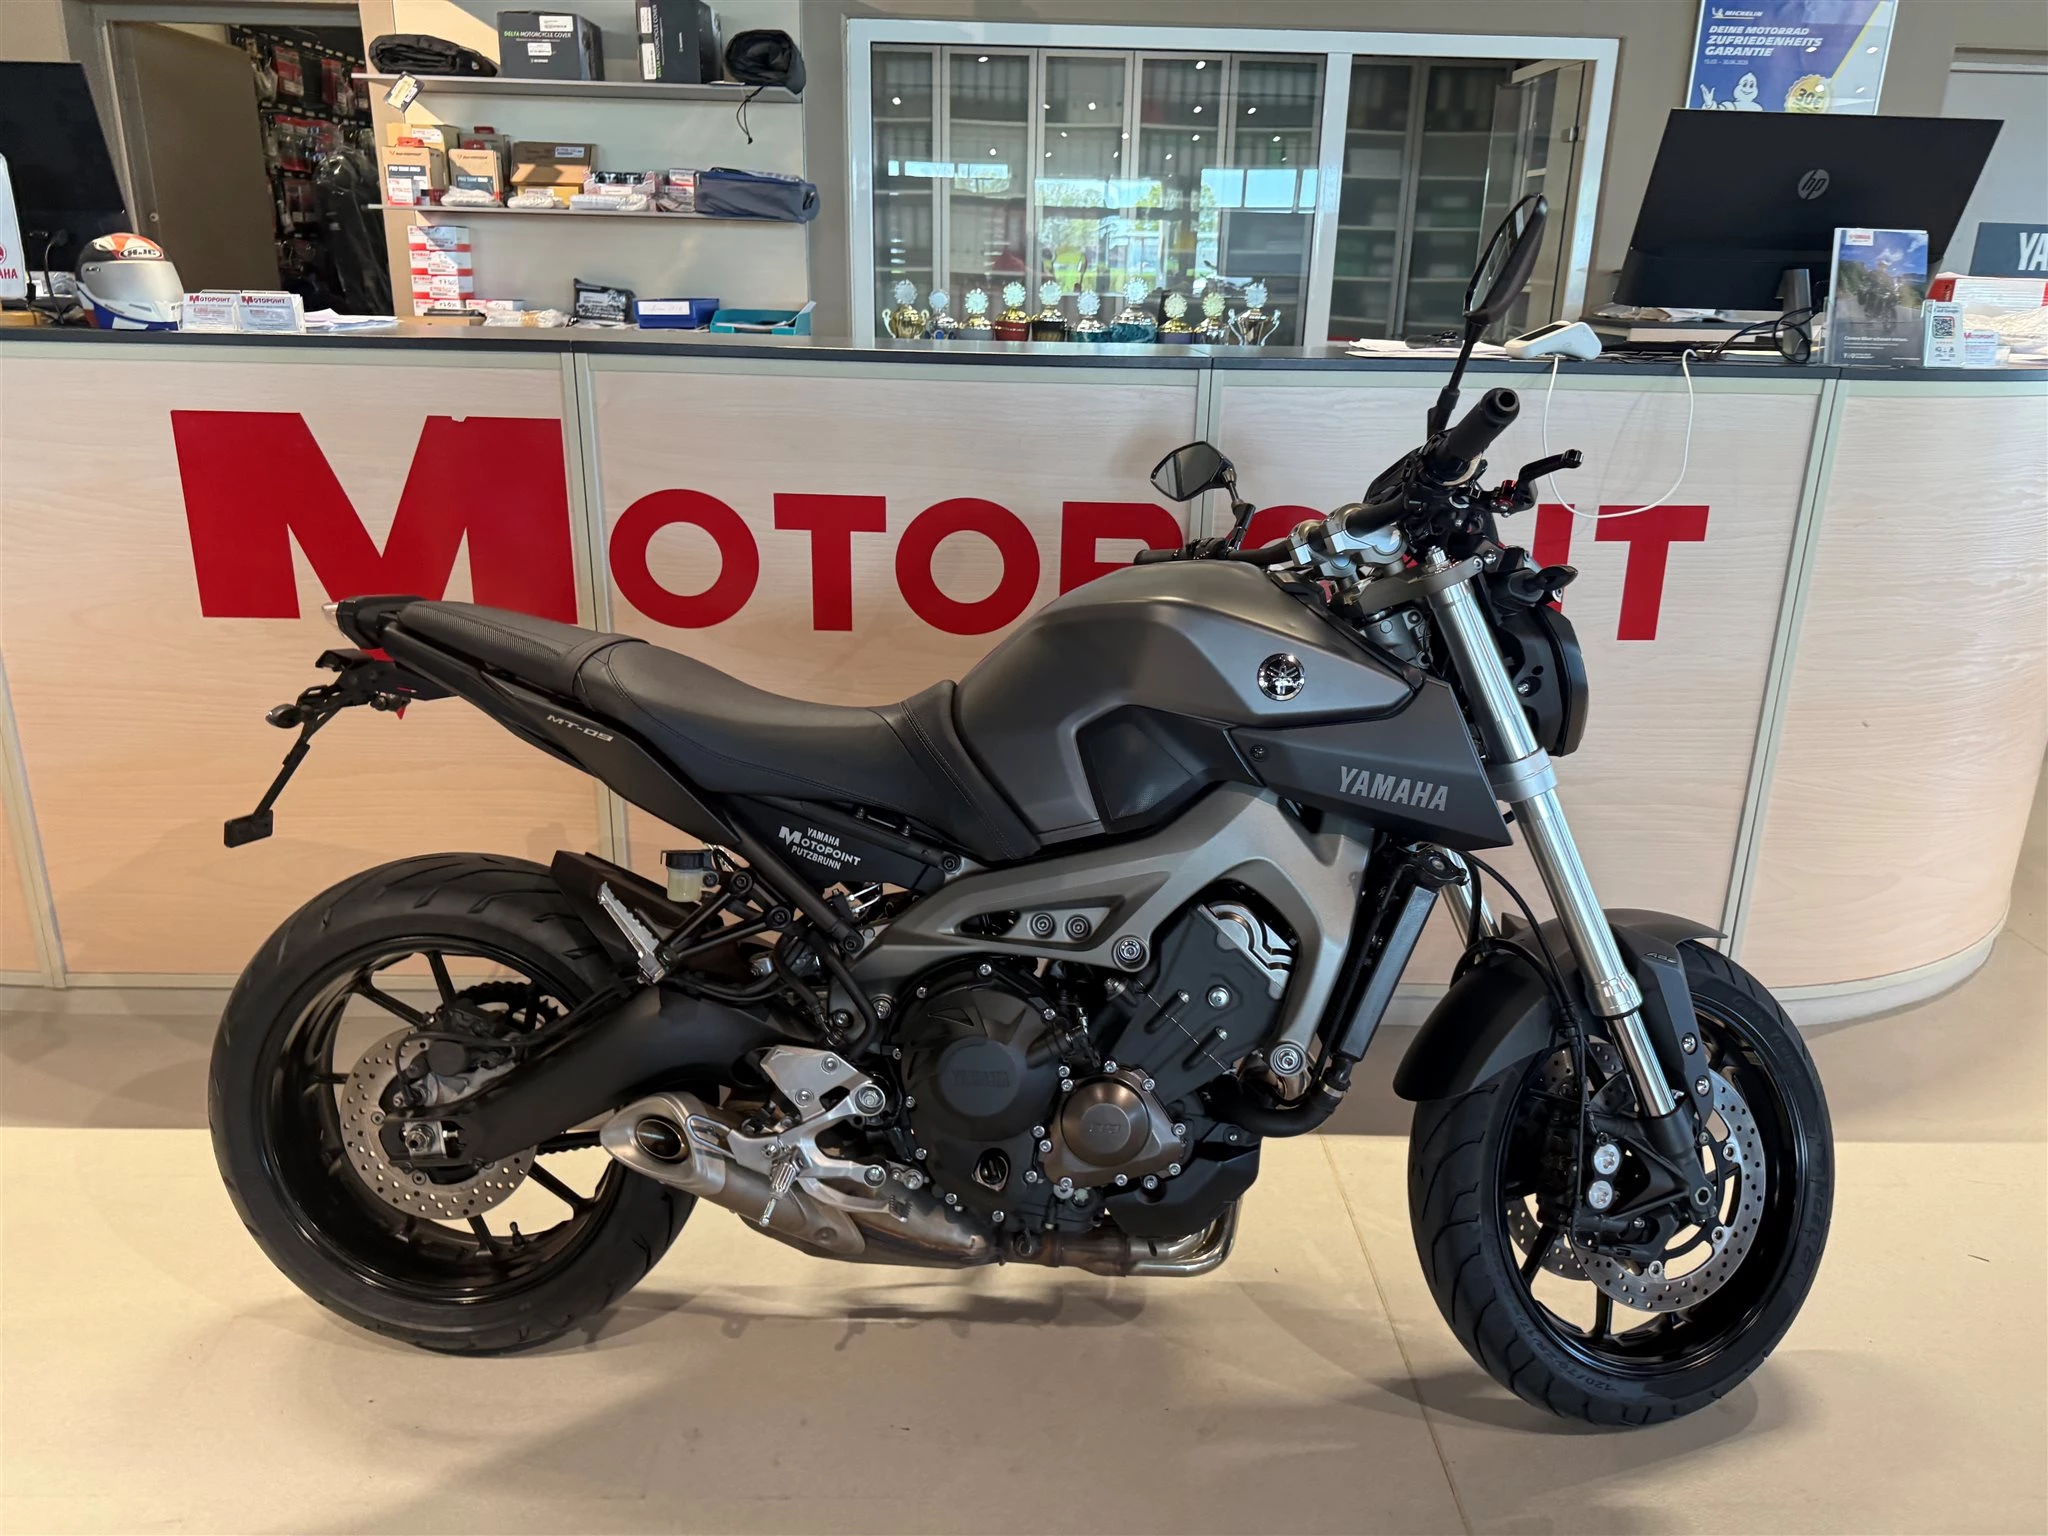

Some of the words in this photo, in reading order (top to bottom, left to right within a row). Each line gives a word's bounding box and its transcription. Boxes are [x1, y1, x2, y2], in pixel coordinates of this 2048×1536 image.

[1706, 35, 1824, 47] ZUFRIEDENHEITS
[1708, 25, 1744, 34] DEINE
[1744, 26, 1810, 36] MOTORRAD
[1704, 46, 1775, 57] GARANTIE
[1800, 169, 1828, 200] hp
[546, 714, 614, 743] MT-09
[1339, 765, 1449, 812] YAMAHA
[778, 825, 861, 867] MOTOPOINT
[807, 827, 840, 847] YAMAHA
[791, 845, 842, 871] PUTZBRUNN
